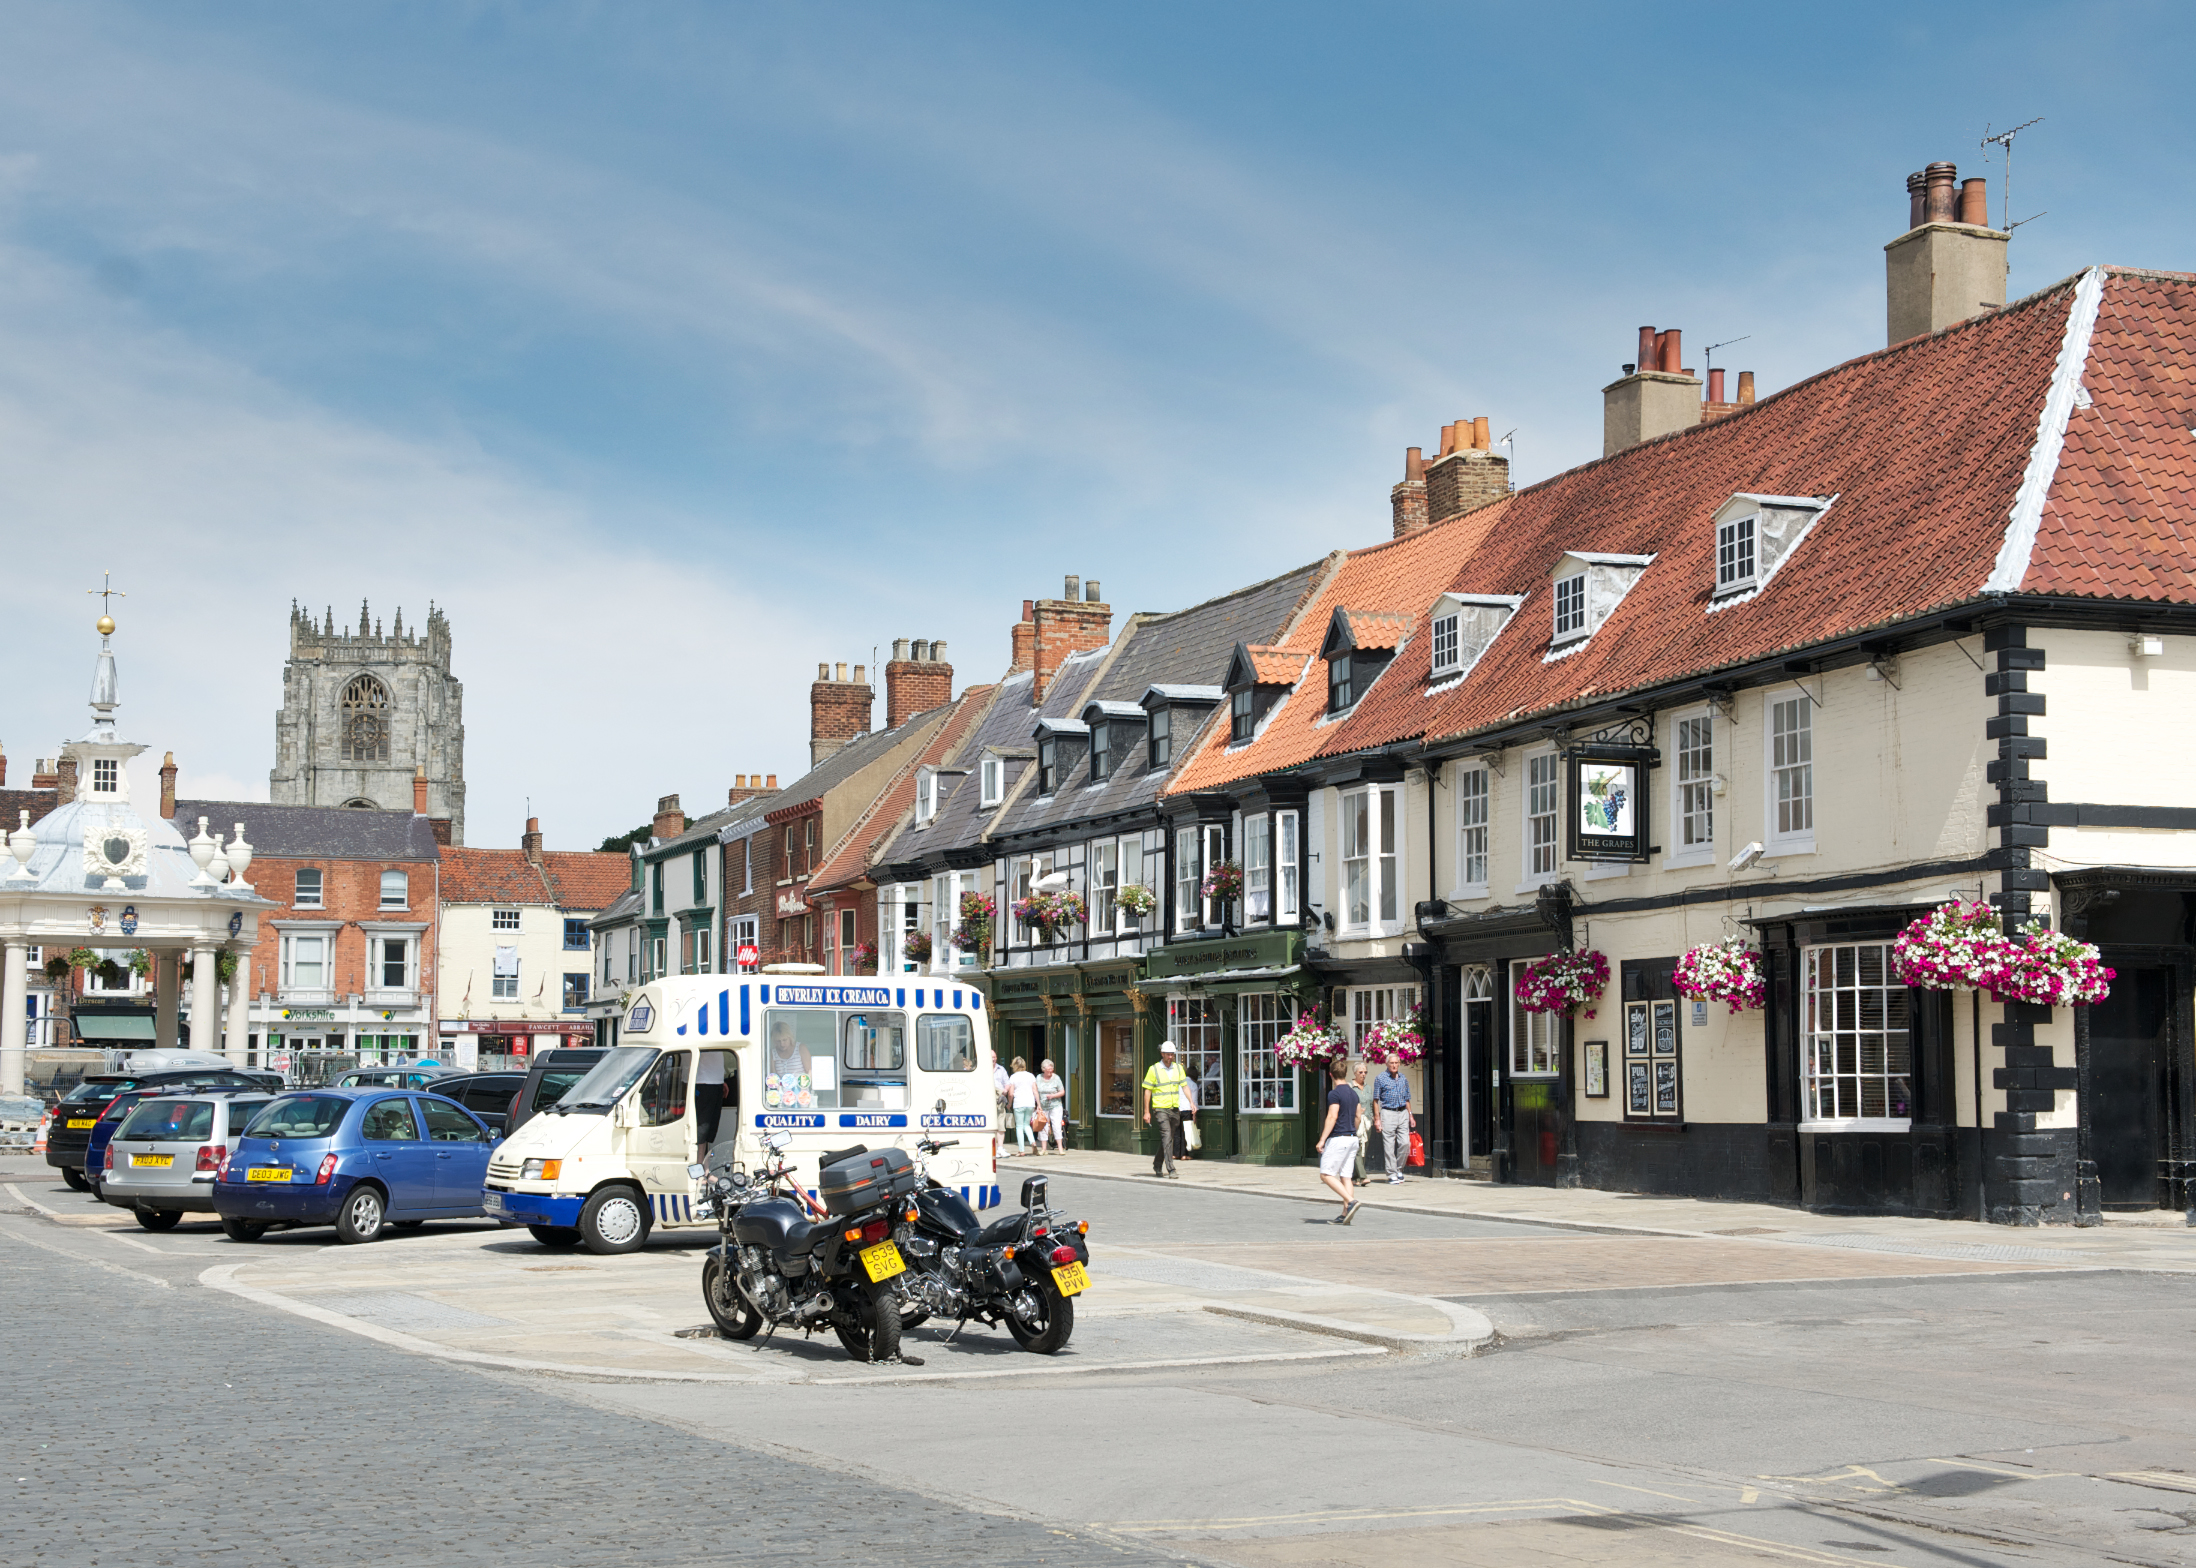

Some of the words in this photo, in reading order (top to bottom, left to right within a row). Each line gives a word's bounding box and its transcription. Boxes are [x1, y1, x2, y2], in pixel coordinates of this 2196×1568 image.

[1581, 839, 1600, 848] THE
[1602, 839, 1635, 849] GRAPES
[738, 947, 758, 965] illy
[778, 987, 824, 1003] BEVERLEY
[826, 988, 841, 1003] ICE
[843, 989, 876, 1004] CREAM
[876, 989, 889, 1005] Co.
[1631, 1009, 1646, 1024] sky
[1631, 1037, 1645, 1050] 3D
[1631, 1066, 1645, 1077] PUB
[763, 1116, 817, 1128] QUALITY
[855, 1116, 891, 1127] DAIRY
[922, 1116, 941, 1127] ICE
[943, 1116, 985, 1127] CREAM
[154, 1155, 170, 1165] XYC
[863, 1244, 896, 1265] L639
[873, 1256, 898, 1275] SVG
[1057, 1264, 1082, 1283] N351
[1063, 1276, 1085, 1292] PVV
